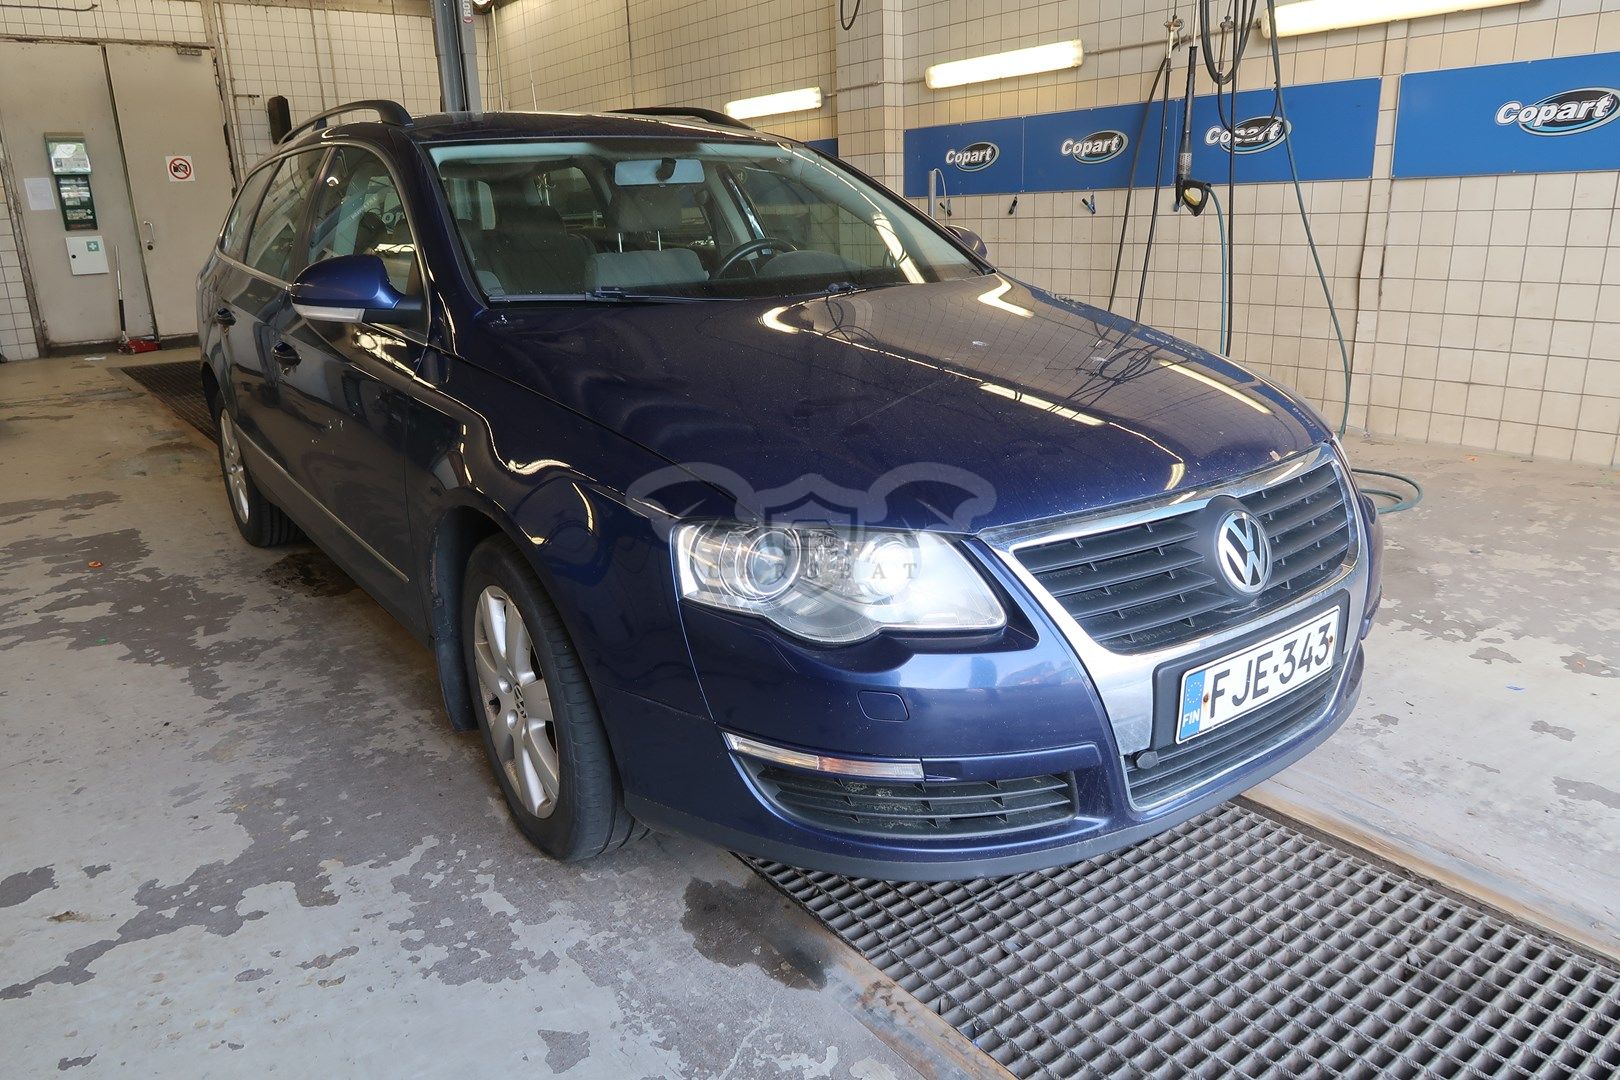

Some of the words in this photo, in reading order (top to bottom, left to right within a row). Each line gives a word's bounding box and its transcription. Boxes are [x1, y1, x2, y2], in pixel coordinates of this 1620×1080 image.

[1495, 92, 1614, 128] Copart
[1061, 135, 1120, 156] Copart
[945, 148, 992, 166] Copart
[1182, 709, 1200, 727] FIN
